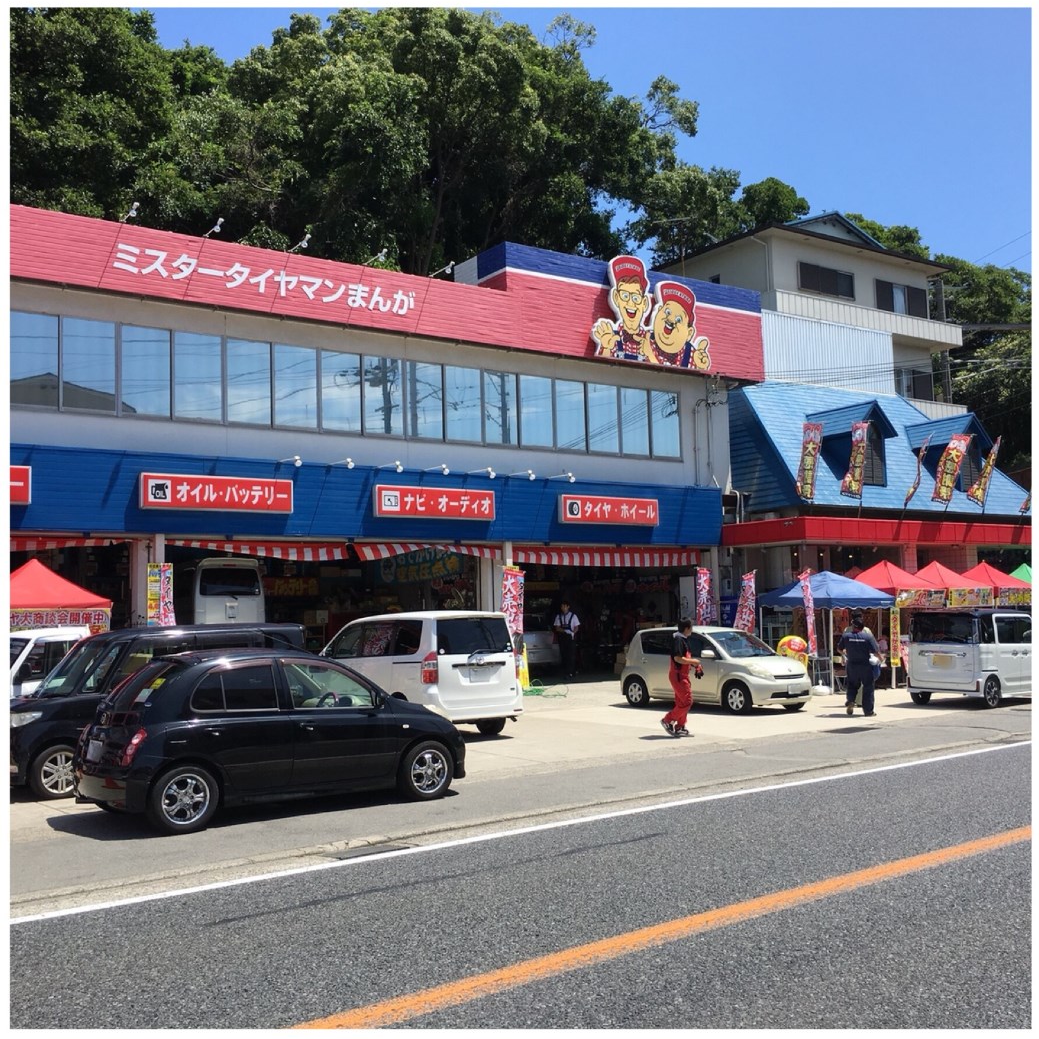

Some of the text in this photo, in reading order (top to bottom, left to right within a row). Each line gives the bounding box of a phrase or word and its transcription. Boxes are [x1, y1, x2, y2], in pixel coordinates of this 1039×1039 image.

[112, 242, 416, 316] ミスタータイヤマンまんが
[176, 481, 288, 504] オイル・バッテリー
[404, 493, 491, 514] ナビ・オーディオ
[584, 502, 655, 519] タイヤ・ホイール
[164, 576, 173, 609] タイヤ
[697, 574, 712, 620] 大売出
